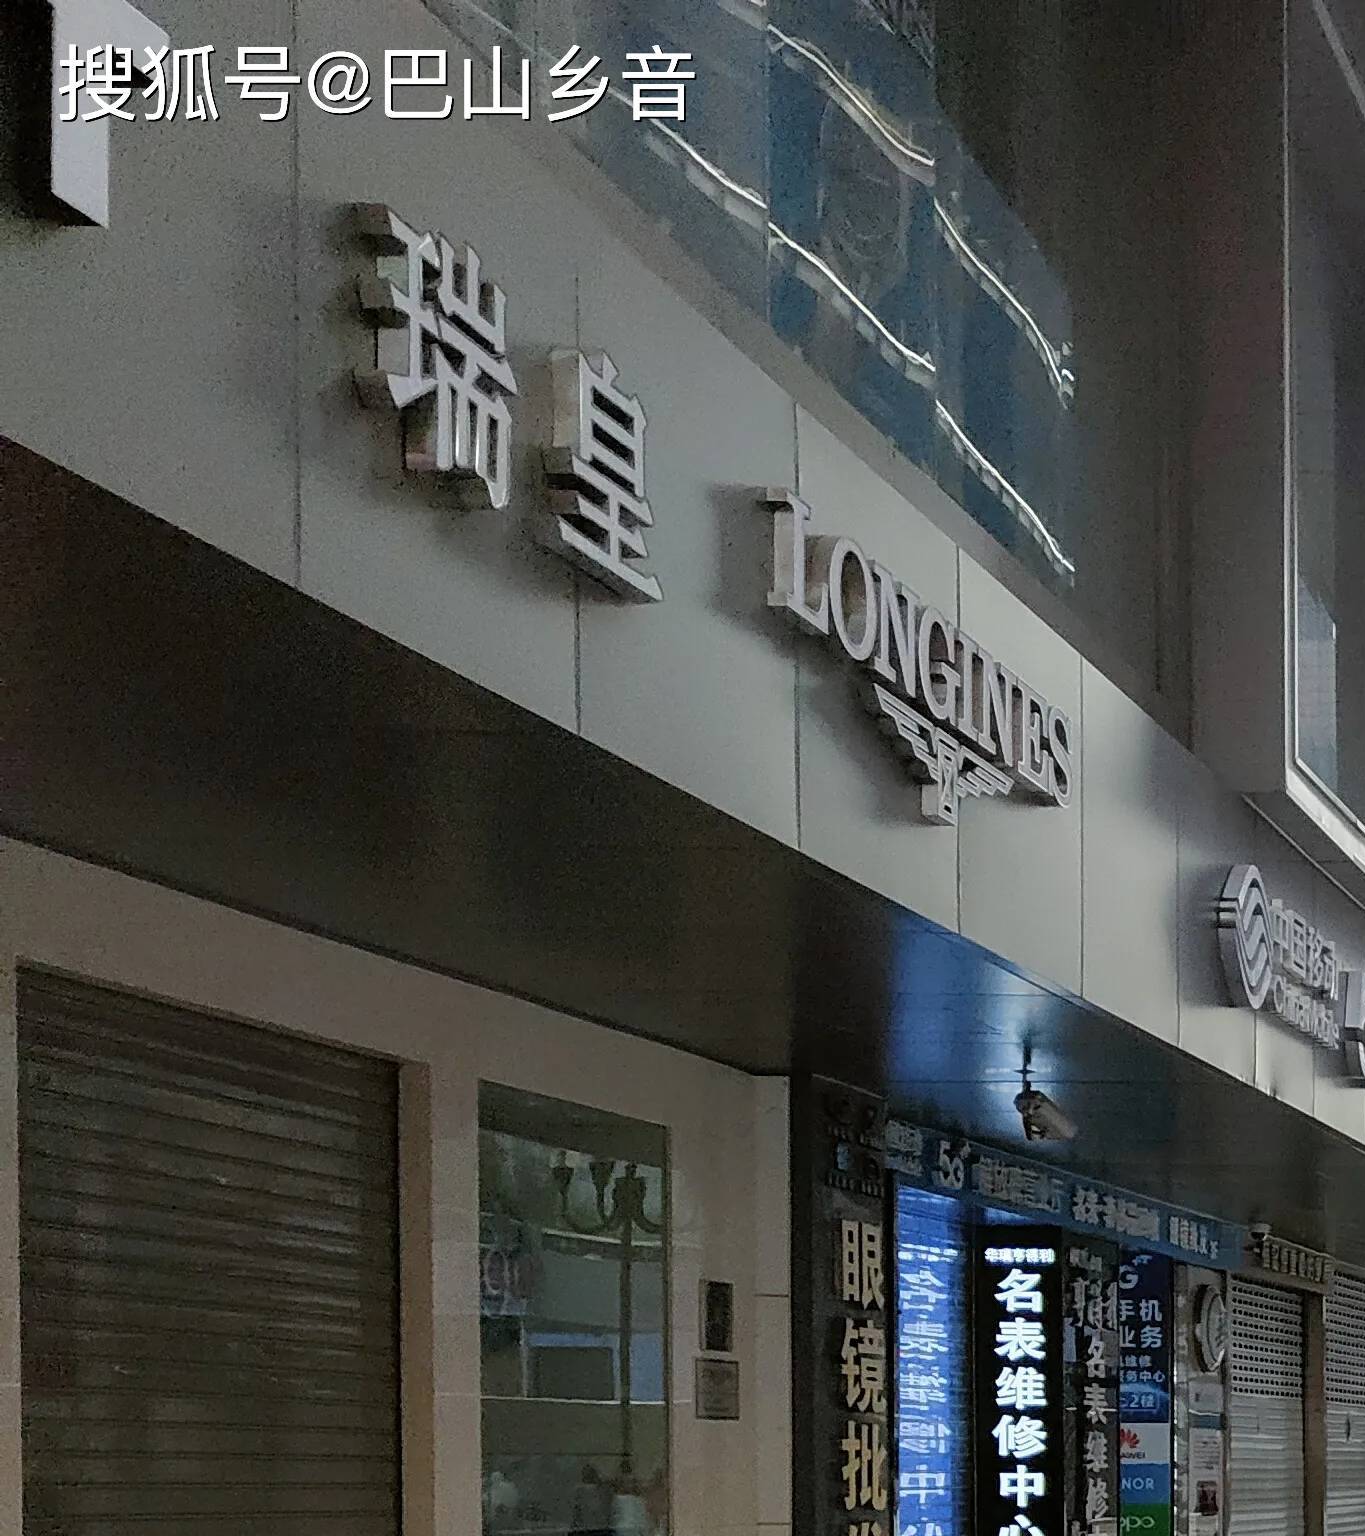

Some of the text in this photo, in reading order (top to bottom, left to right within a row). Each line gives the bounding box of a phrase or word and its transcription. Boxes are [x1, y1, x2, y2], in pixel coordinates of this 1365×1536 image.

[355, 203, 662, 602] 瑞皇
[762, 488, 1071, 808] LONGINES
[1271, 899, 1338, 1000] 中国移动
